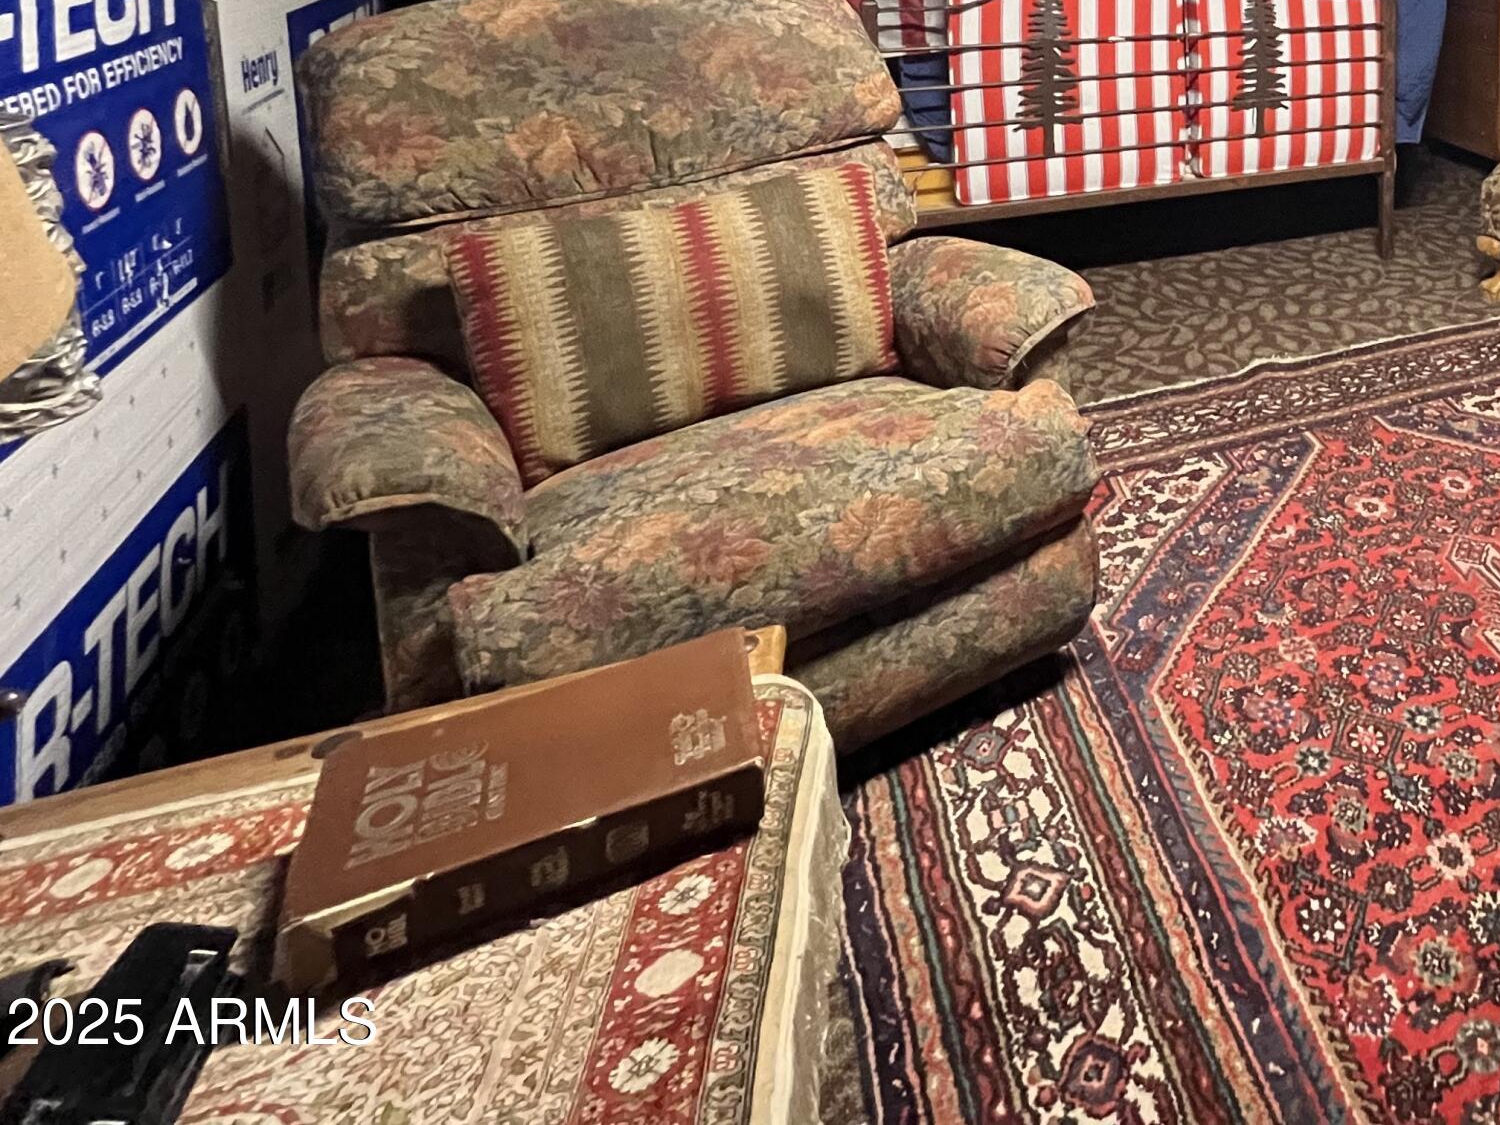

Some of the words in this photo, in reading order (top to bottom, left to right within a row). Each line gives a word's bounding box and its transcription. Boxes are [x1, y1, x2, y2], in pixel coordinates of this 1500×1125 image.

[62, 67, 103, 105] FOR
[102, 36, 184, 90] EFFICIENCY
[240, 49, 280, 96] Henry
[16, 458, 228, 805] R-TECH
[342, 759, 427, 872] HOLY
